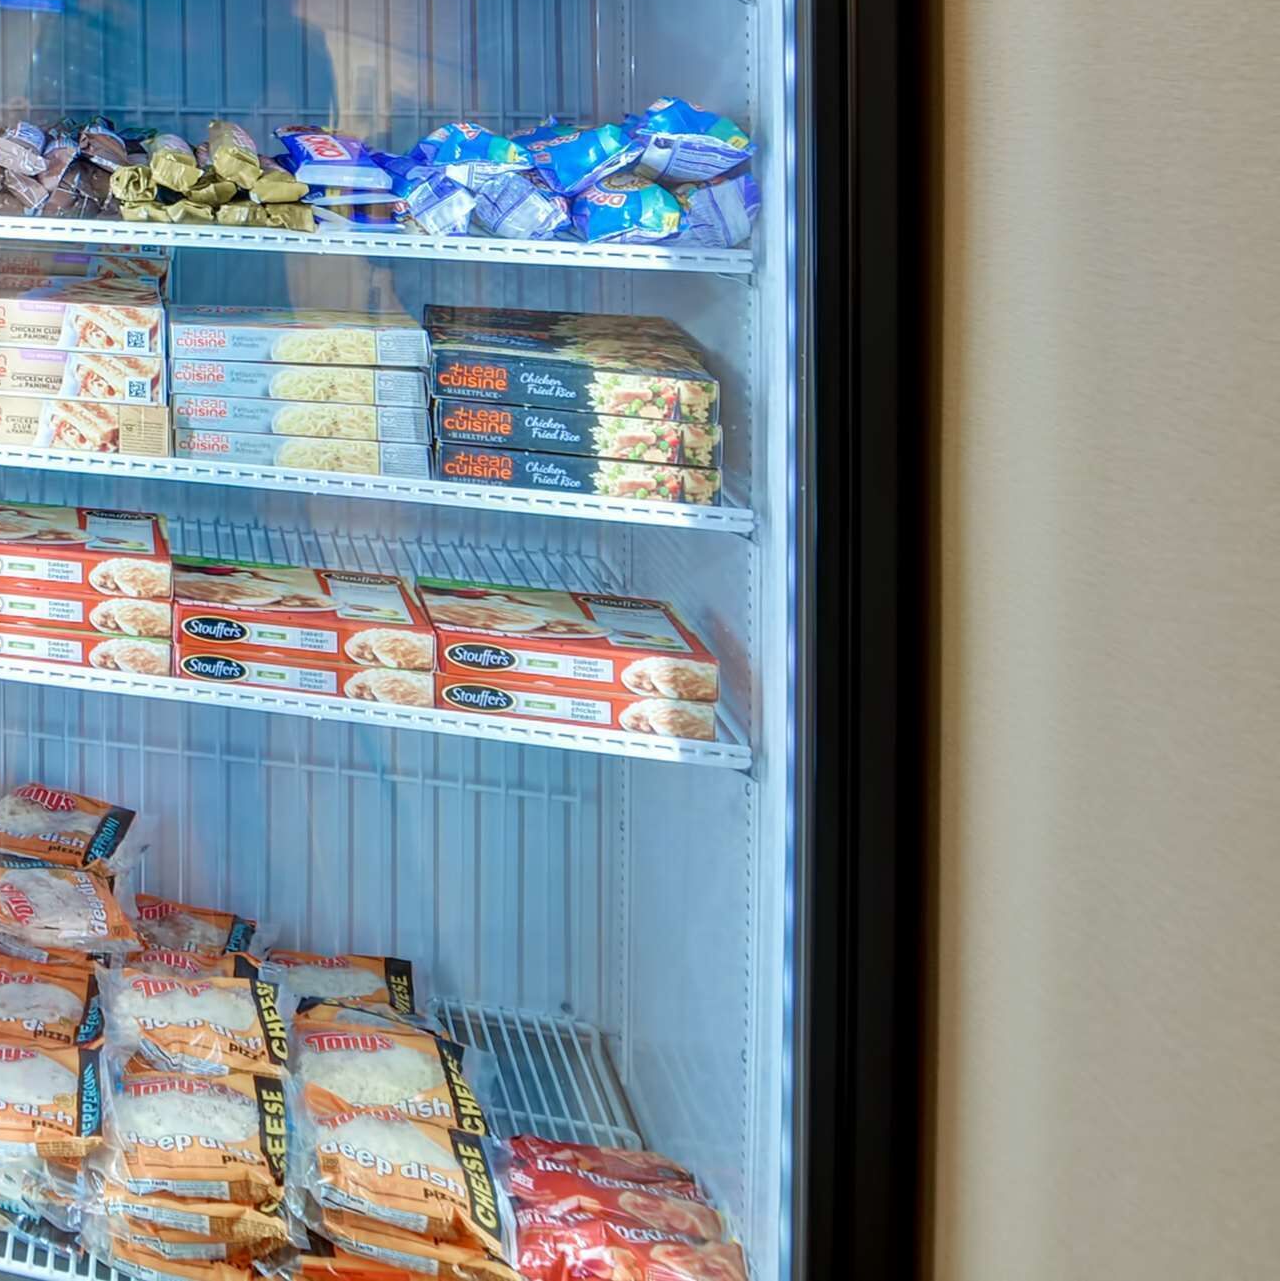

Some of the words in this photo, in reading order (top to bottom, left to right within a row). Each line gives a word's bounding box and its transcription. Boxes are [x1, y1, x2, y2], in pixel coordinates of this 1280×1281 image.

[520, 372, 562, 387] Chicken
[445, 388, 501, 400] MARKETPLACE
[527, 385, 555, 398] Fried
[555, 385, 577, 400] Rice
[524, 416, 567, 431] Chicken
[450, 431, 505, 443] MARKETPLACE
[531, 428, 560, 442] Fried
[560, 430, 581, 443] Rice
[525, 461, 567, 476] Chicken
[532, 474, 560, 487] Fried
[560, 475, 582, 489] Rice
[189, 619, 242, 639] Stouffer's
[453, 646, 510, 668] Stouffer's
[188, 658, 242, 678] Stouffer's
[451, 687, 508, 709] Stouffer's
[39, 832, 86, 849] dish
[47, 845, 82, 856] pizza
[33, 1029, 72, 1044] pizza
[304, 1031, 393, 1053] Tony's
[320, 1140, 395, 1177] deep
[400, 1161, 467, 1197] dish
[464, 1141, 498, 1230] CHEESE
